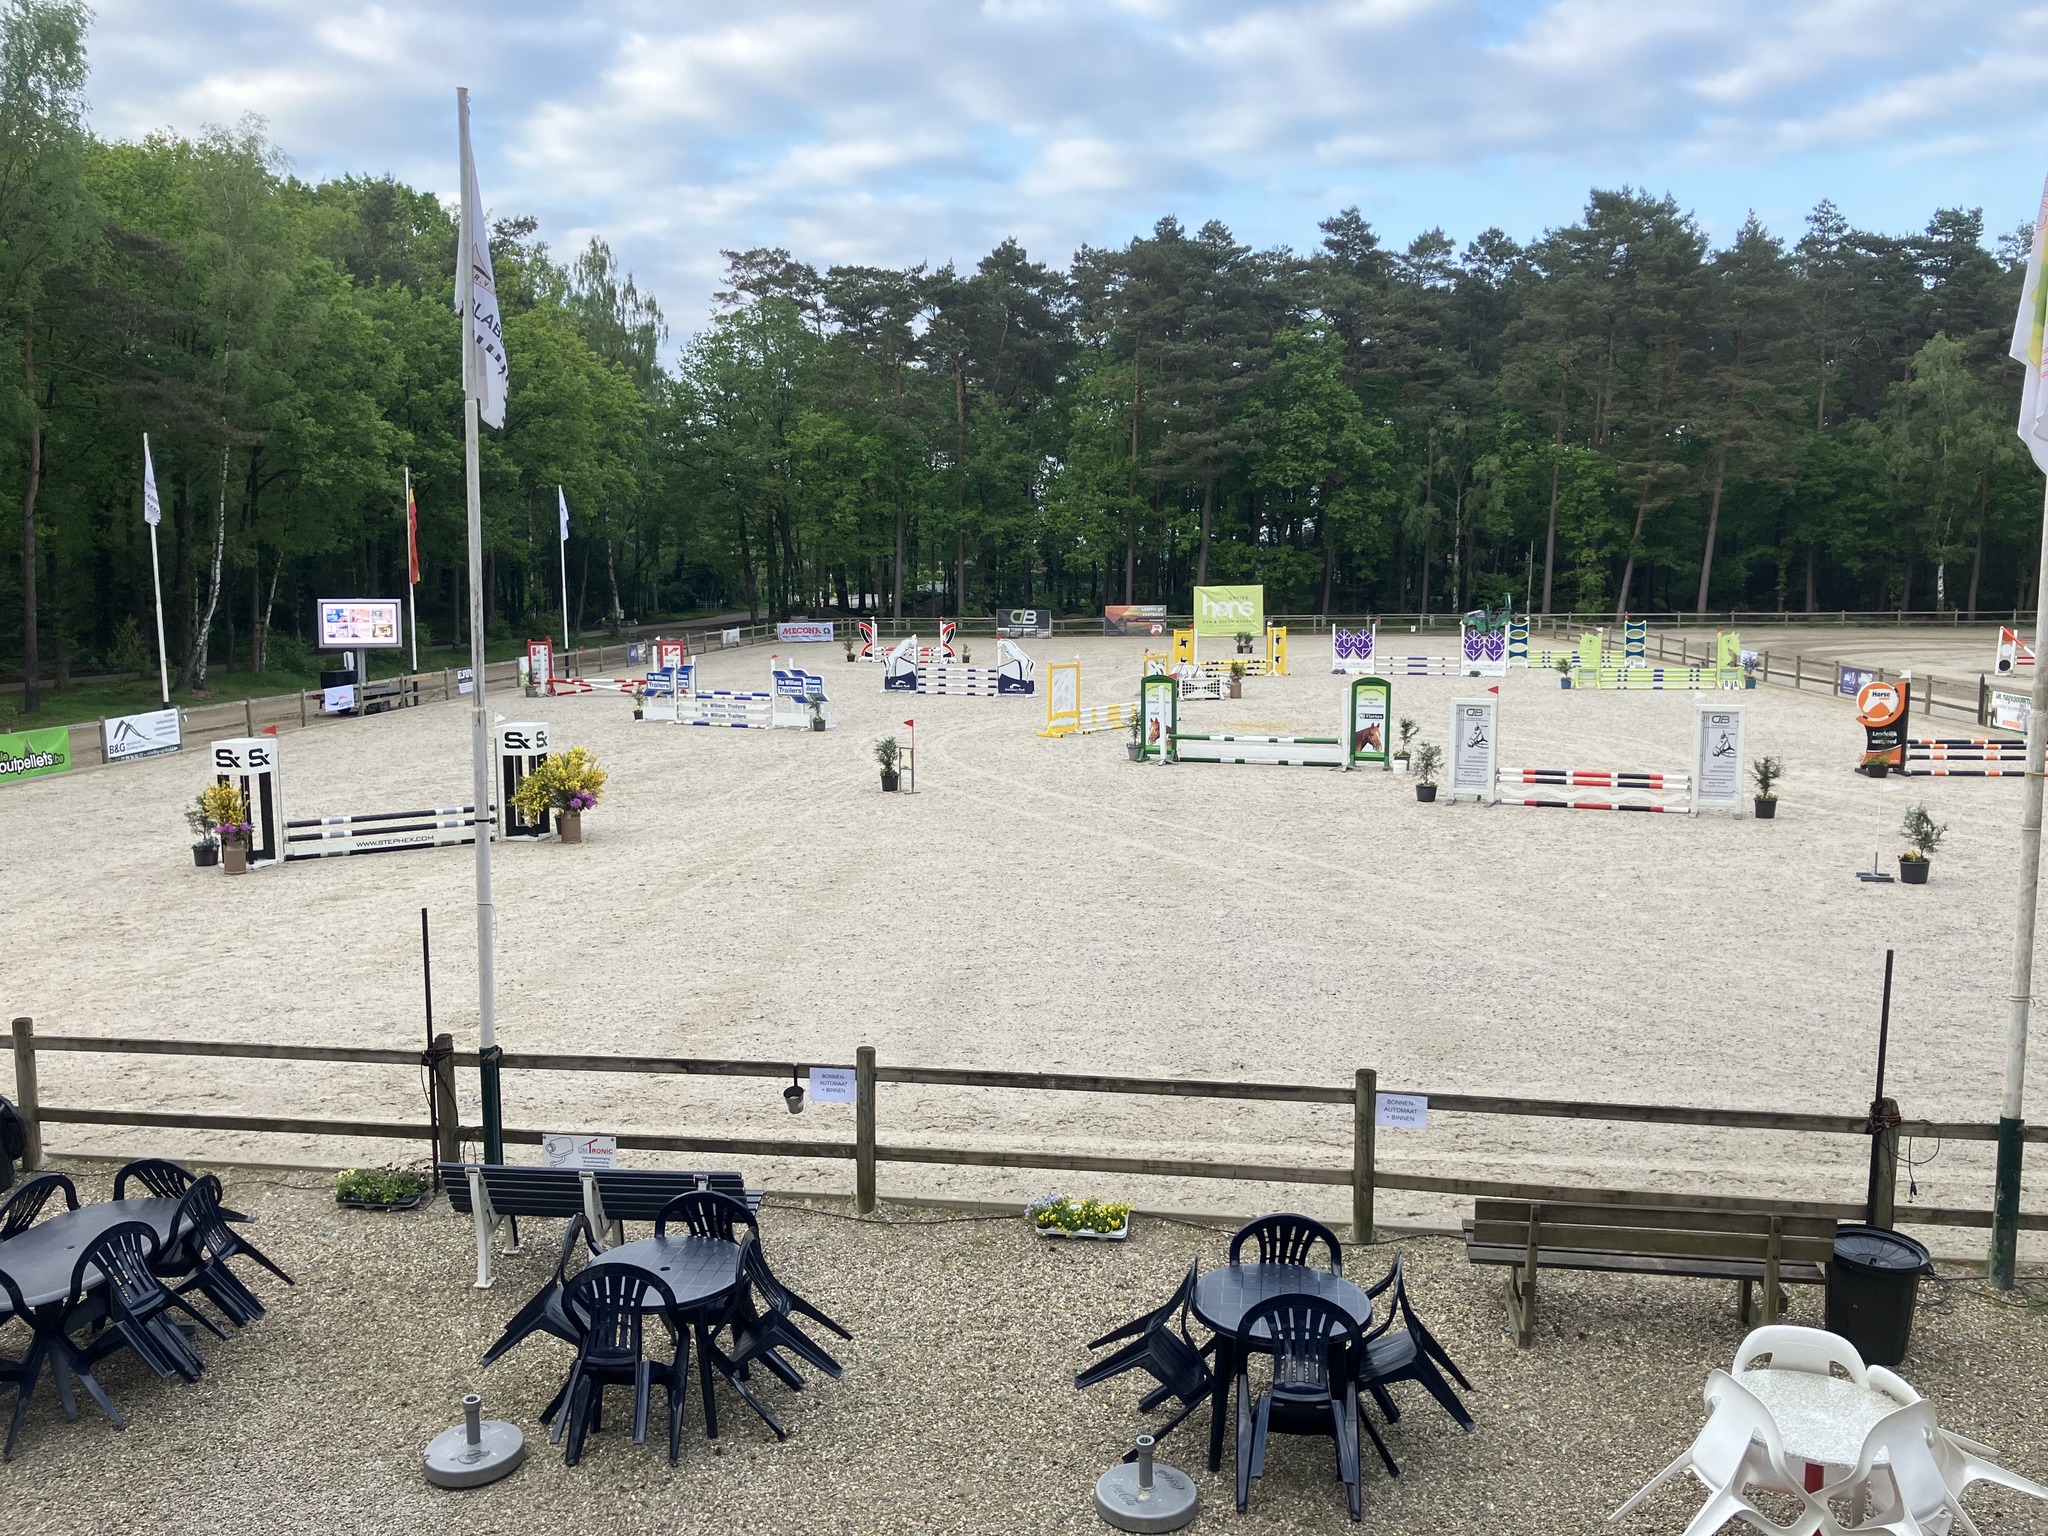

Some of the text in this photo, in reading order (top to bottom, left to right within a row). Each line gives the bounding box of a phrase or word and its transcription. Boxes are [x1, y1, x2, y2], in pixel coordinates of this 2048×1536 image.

[779, 686, 802, 694] Trailers
[109, 742, 126, 755] B&G
[356, 835, 435, 848] WWW.STEPHEX.COM
[1386, 1098, 1415, 1106] BONNEN-
[1383, 1106, 1418, 1115] AUTOMAAT
[1391, 1114, 1415, 1122] BINNEN
